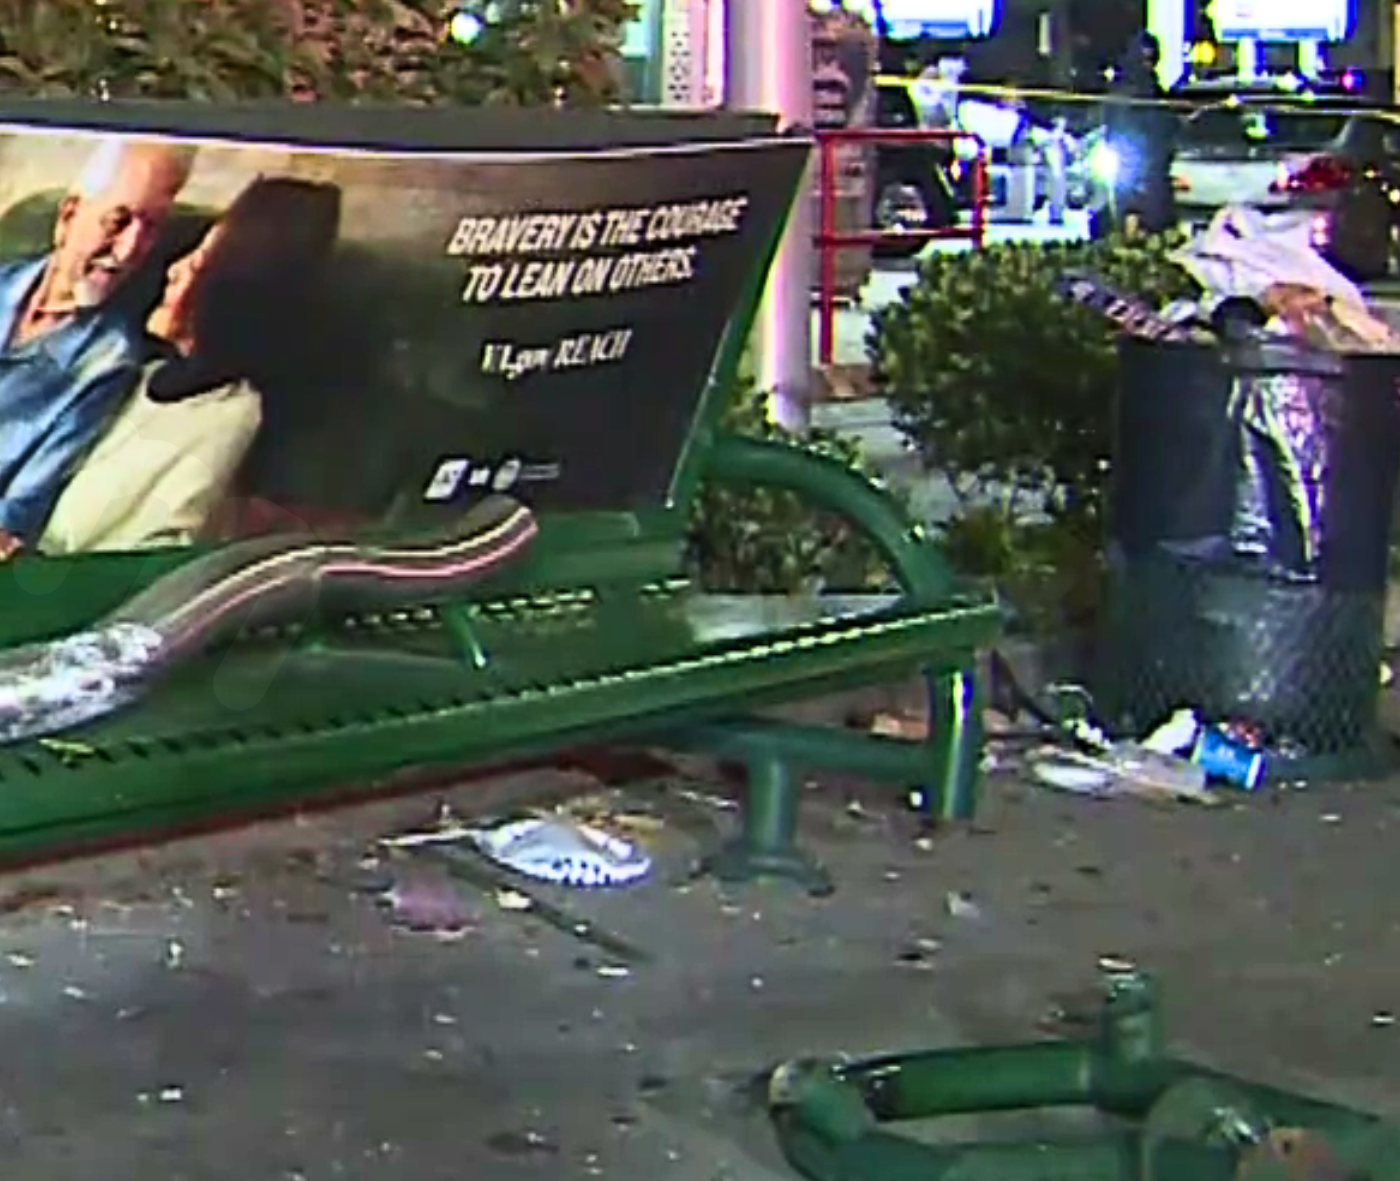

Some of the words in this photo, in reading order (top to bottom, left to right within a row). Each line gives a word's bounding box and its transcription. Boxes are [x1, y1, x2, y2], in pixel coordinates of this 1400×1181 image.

[447, 213, 576, 255] BRAVERY
[569, 212, 600, 249] IS
[600, 209, 650, 246] THE
[644, 197, 748, 241] COURAGE
[461, 267, 503, 303] TO
[499, 260, 575, 299] LEAN
[570, 257, 613, 295] ON
